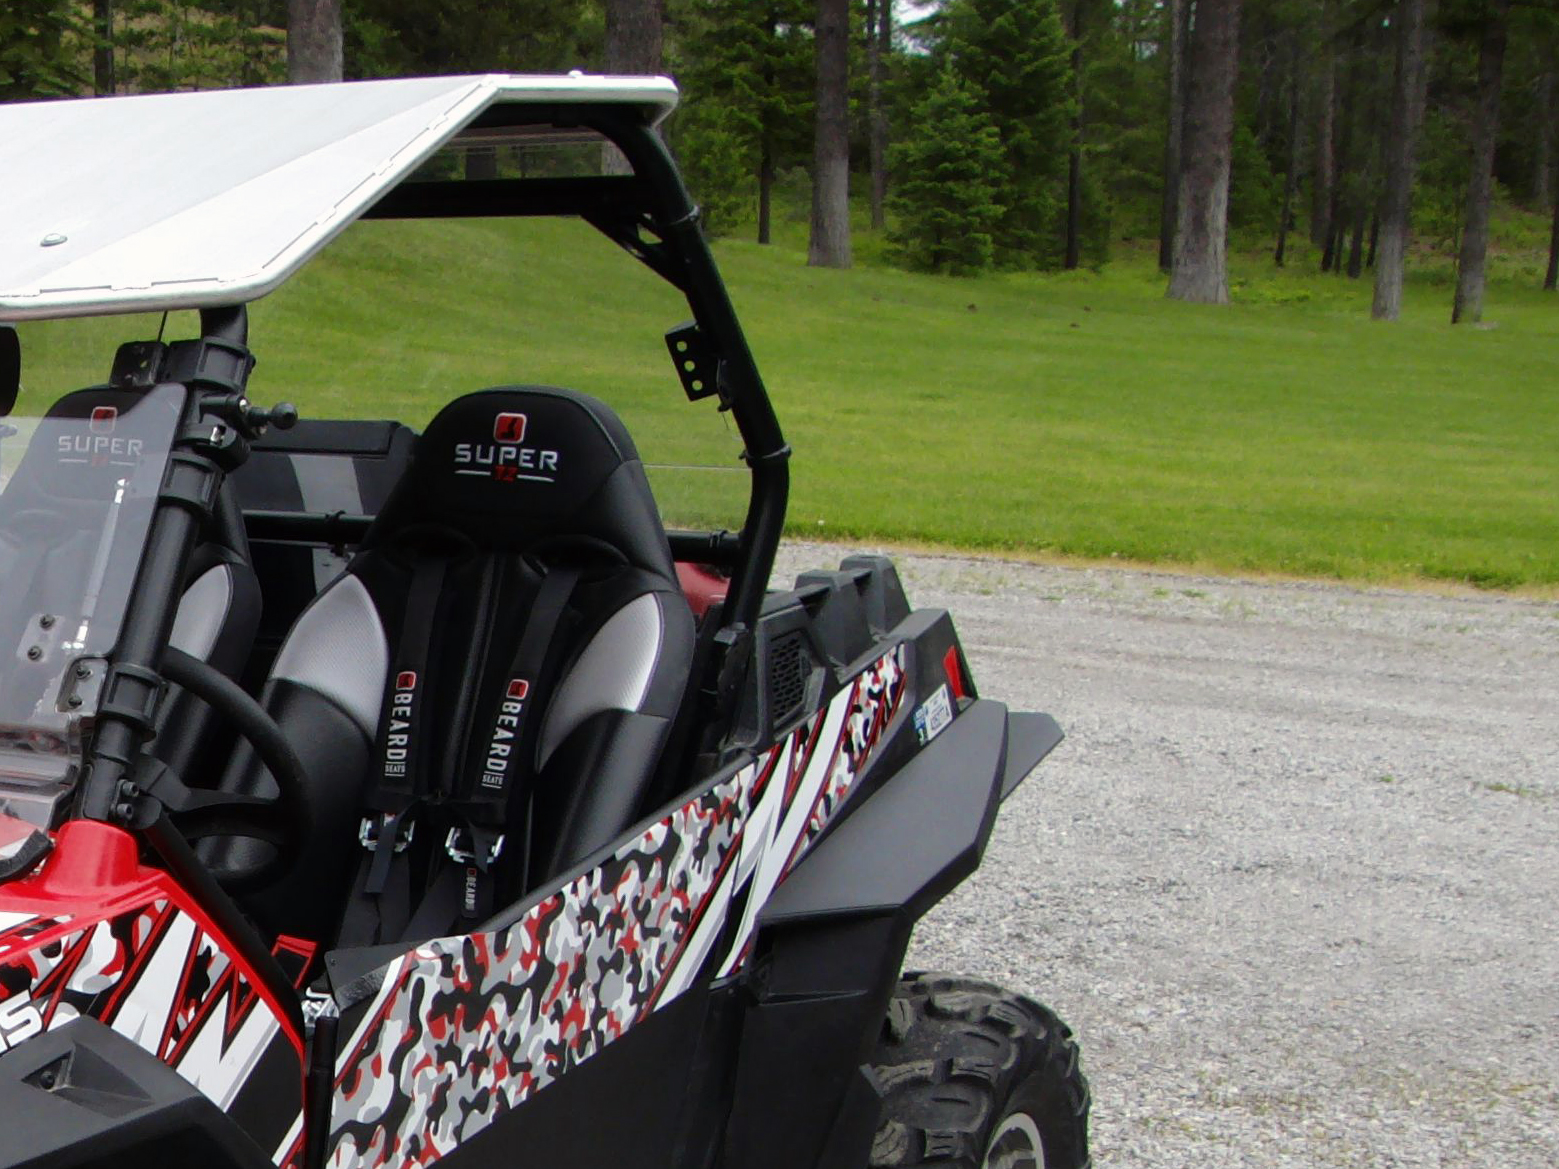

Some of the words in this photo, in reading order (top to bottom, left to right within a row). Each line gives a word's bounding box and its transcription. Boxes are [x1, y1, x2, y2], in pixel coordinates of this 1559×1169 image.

[58, 435, 143, 456] SUPER
[454, 443, 558, 471] SUPER
[386, 693, 413, 760] BEARD
[486, 701, 522, 771] BEARD
[384, 763, 406, 773] SEATS
[482, 774, 504, 786] SEATS
